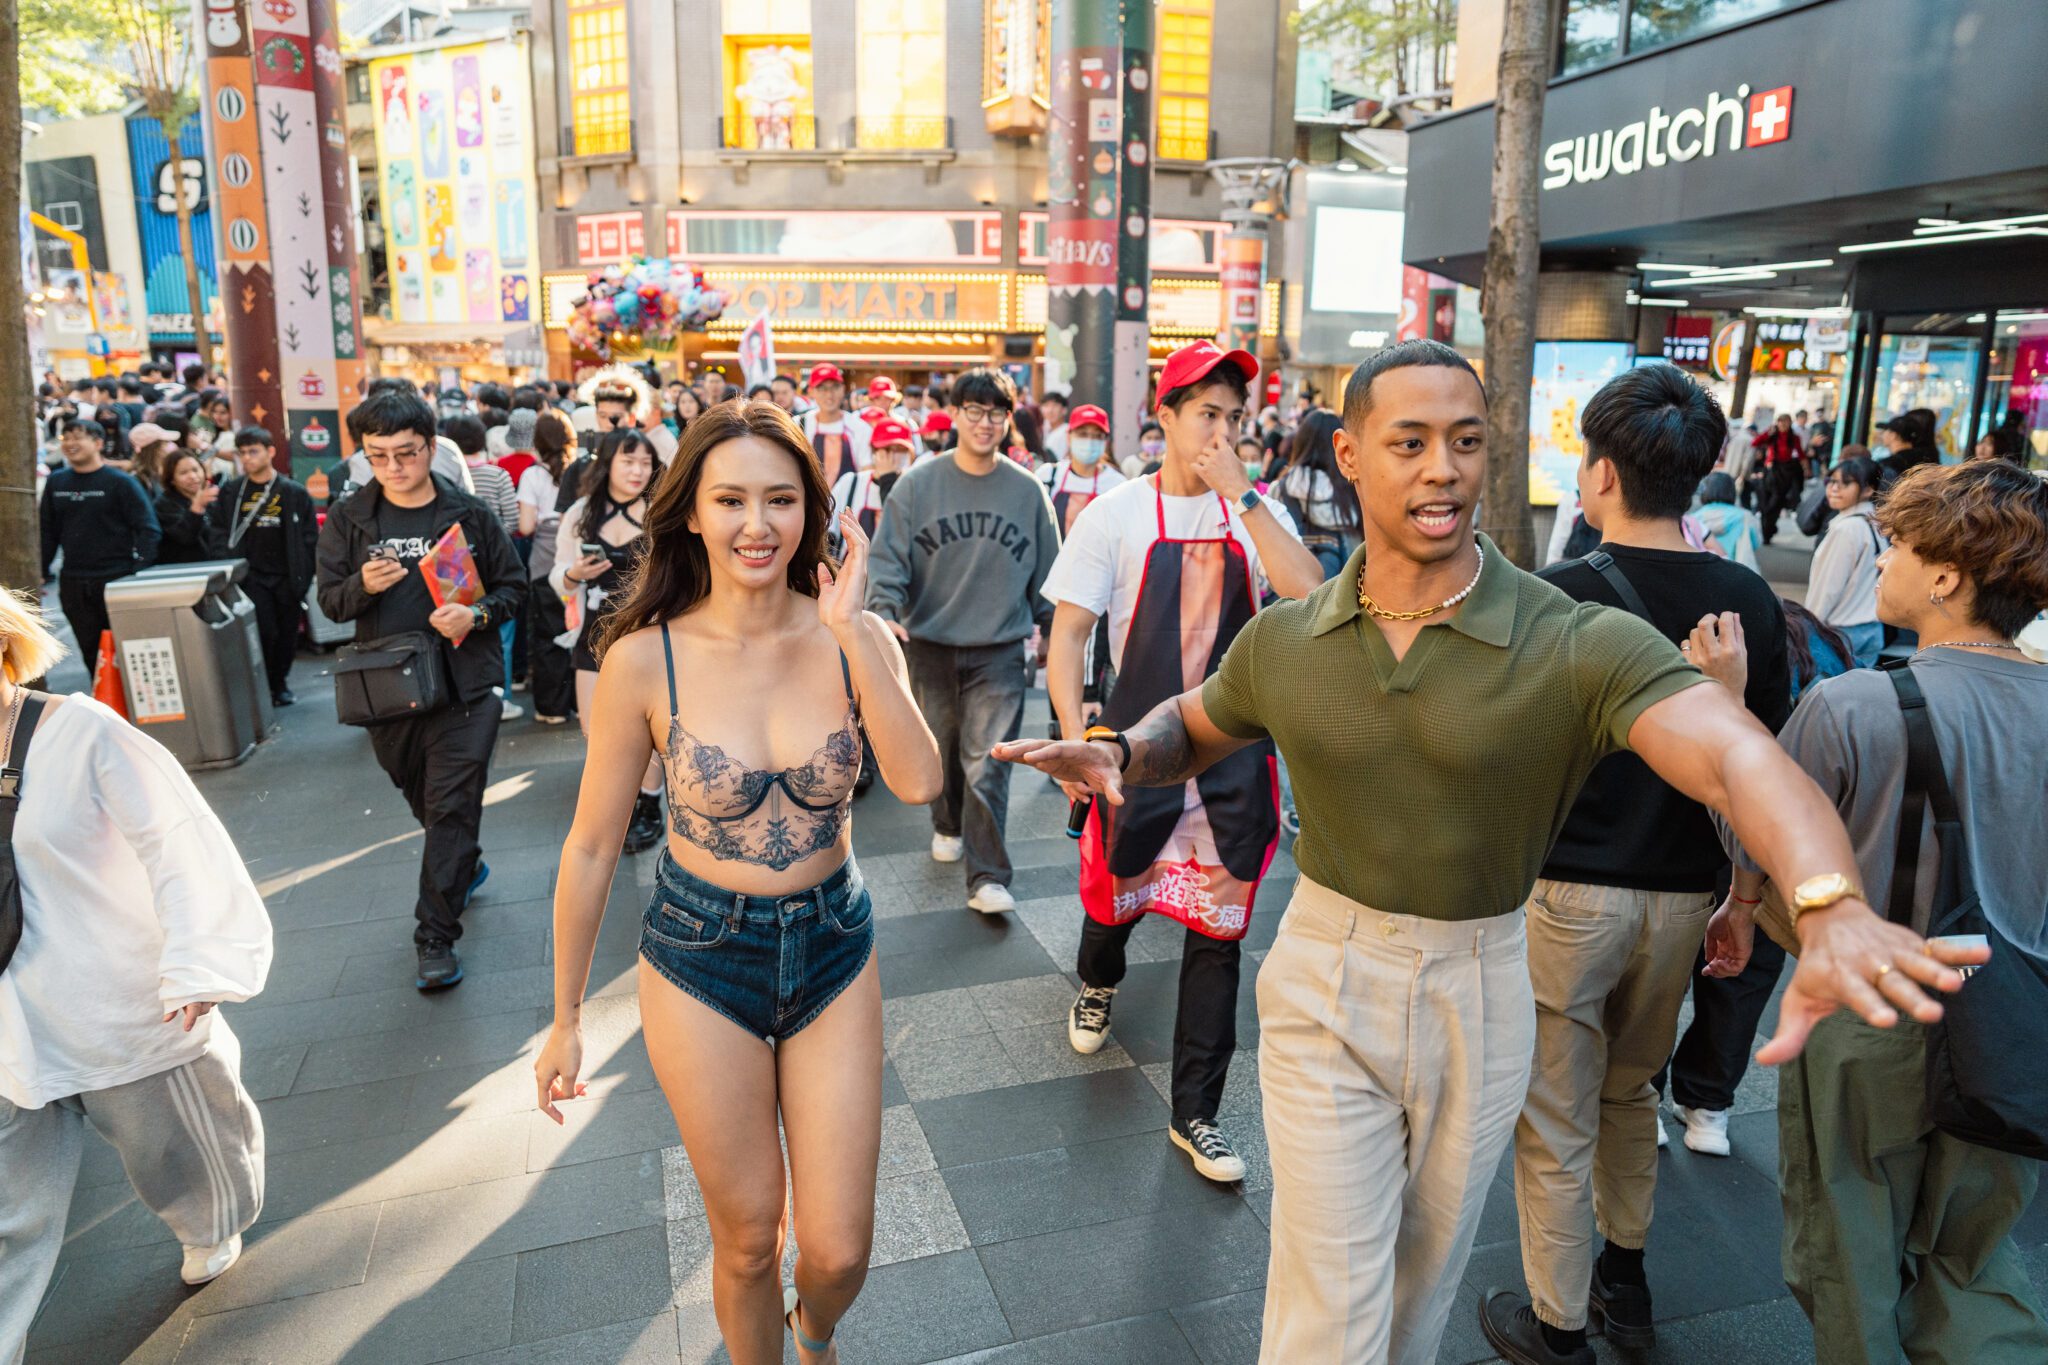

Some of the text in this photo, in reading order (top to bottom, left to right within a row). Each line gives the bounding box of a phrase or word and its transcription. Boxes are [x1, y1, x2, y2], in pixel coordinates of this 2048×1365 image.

[1543, 84, 1748, 190] swatch
[819, 281, 956, 320] MART
[914, 512, 1031, 562] NAUTICA
